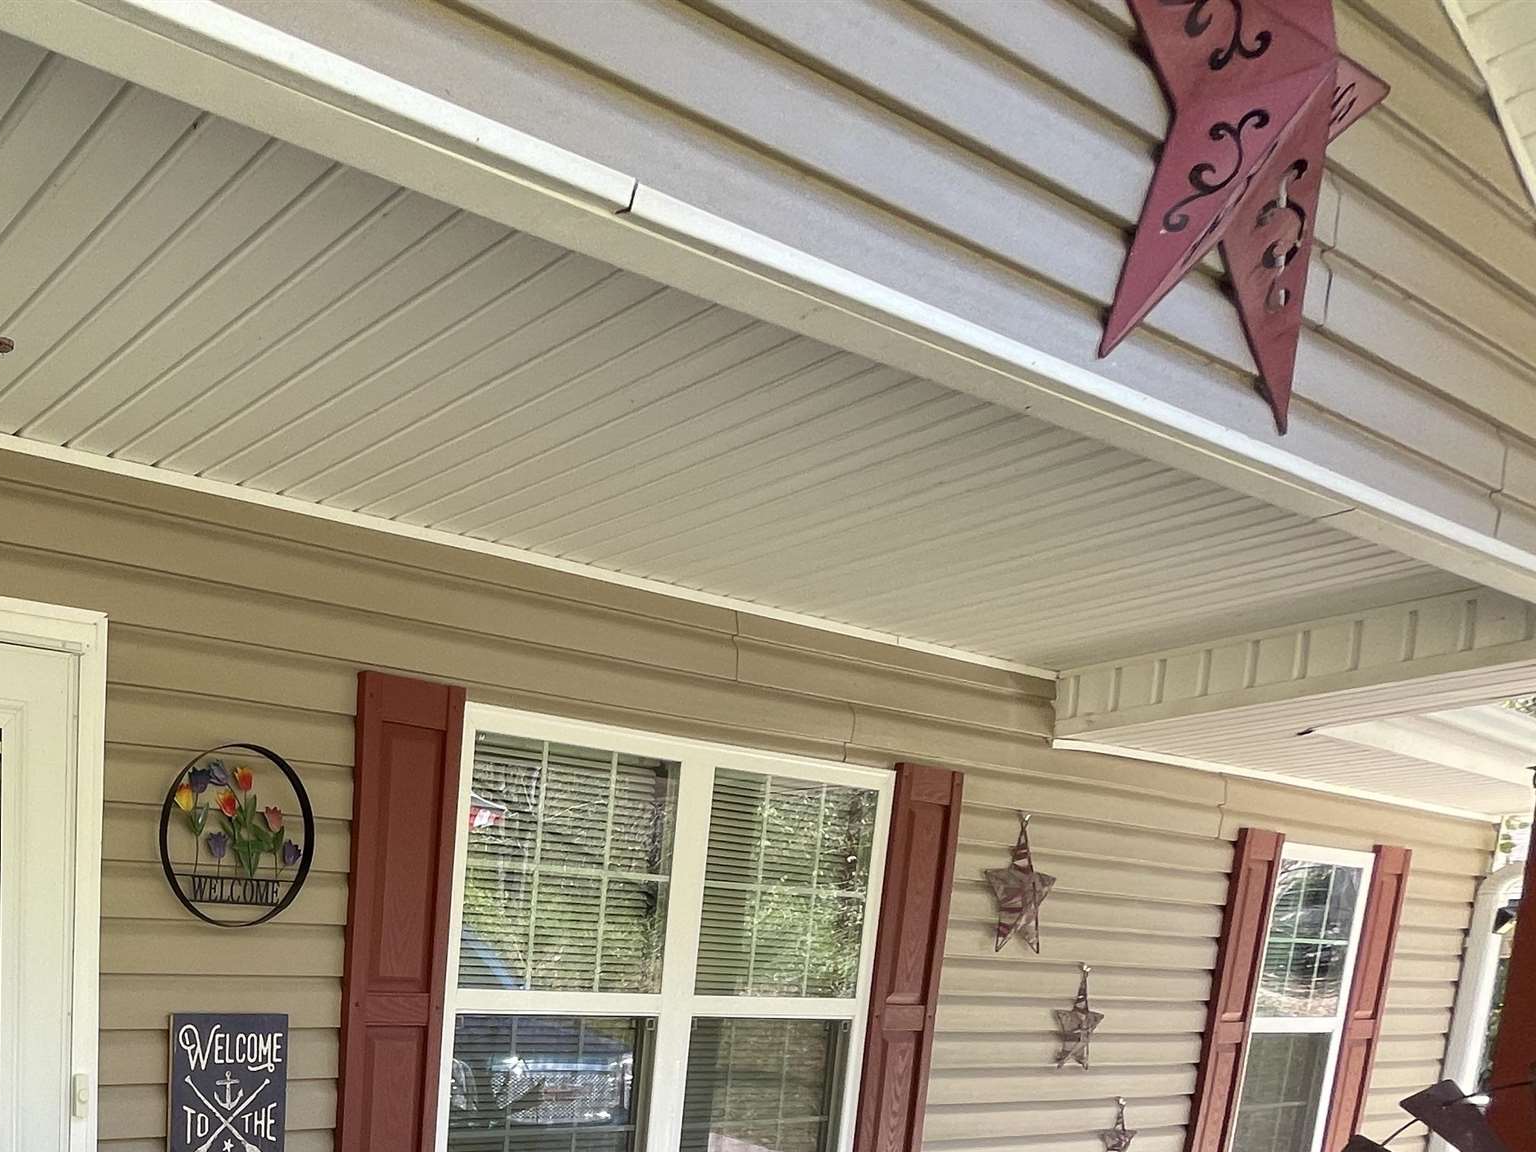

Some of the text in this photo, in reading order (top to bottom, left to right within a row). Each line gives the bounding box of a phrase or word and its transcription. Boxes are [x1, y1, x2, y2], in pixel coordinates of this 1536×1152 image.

[192, 876, 280, 905] WELCOME
[178, 1023, 283, 1072] WELCOME
[182, 1102, 278, 1144] TO THE
